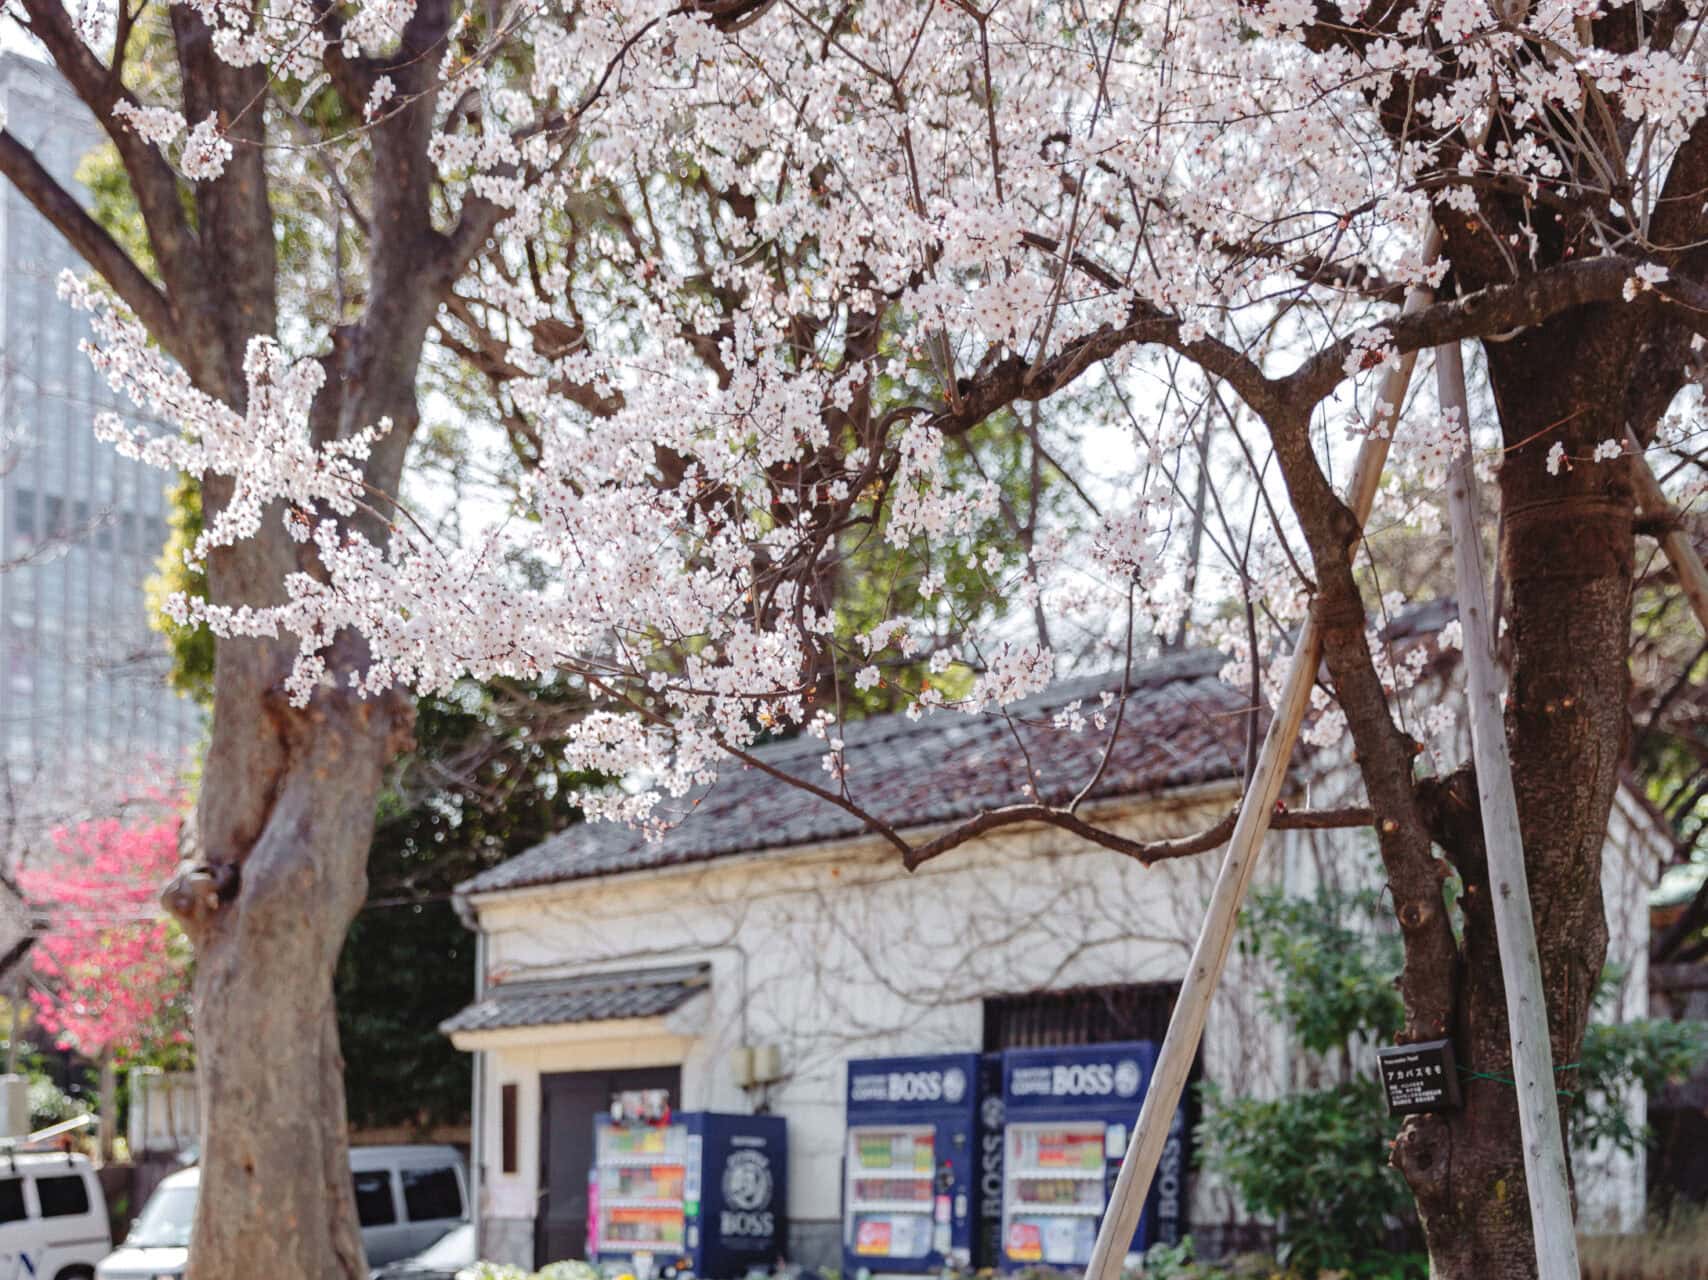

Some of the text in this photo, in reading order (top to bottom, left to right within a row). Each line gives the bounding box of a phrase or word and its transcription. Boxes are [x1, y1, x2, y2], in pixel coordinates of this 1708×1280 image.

[887, 1071, 942, 1102] BOSS
[1053, 1064, 1113, 1096] BOSS
[719, 1210, 775, 1237] BOSS
